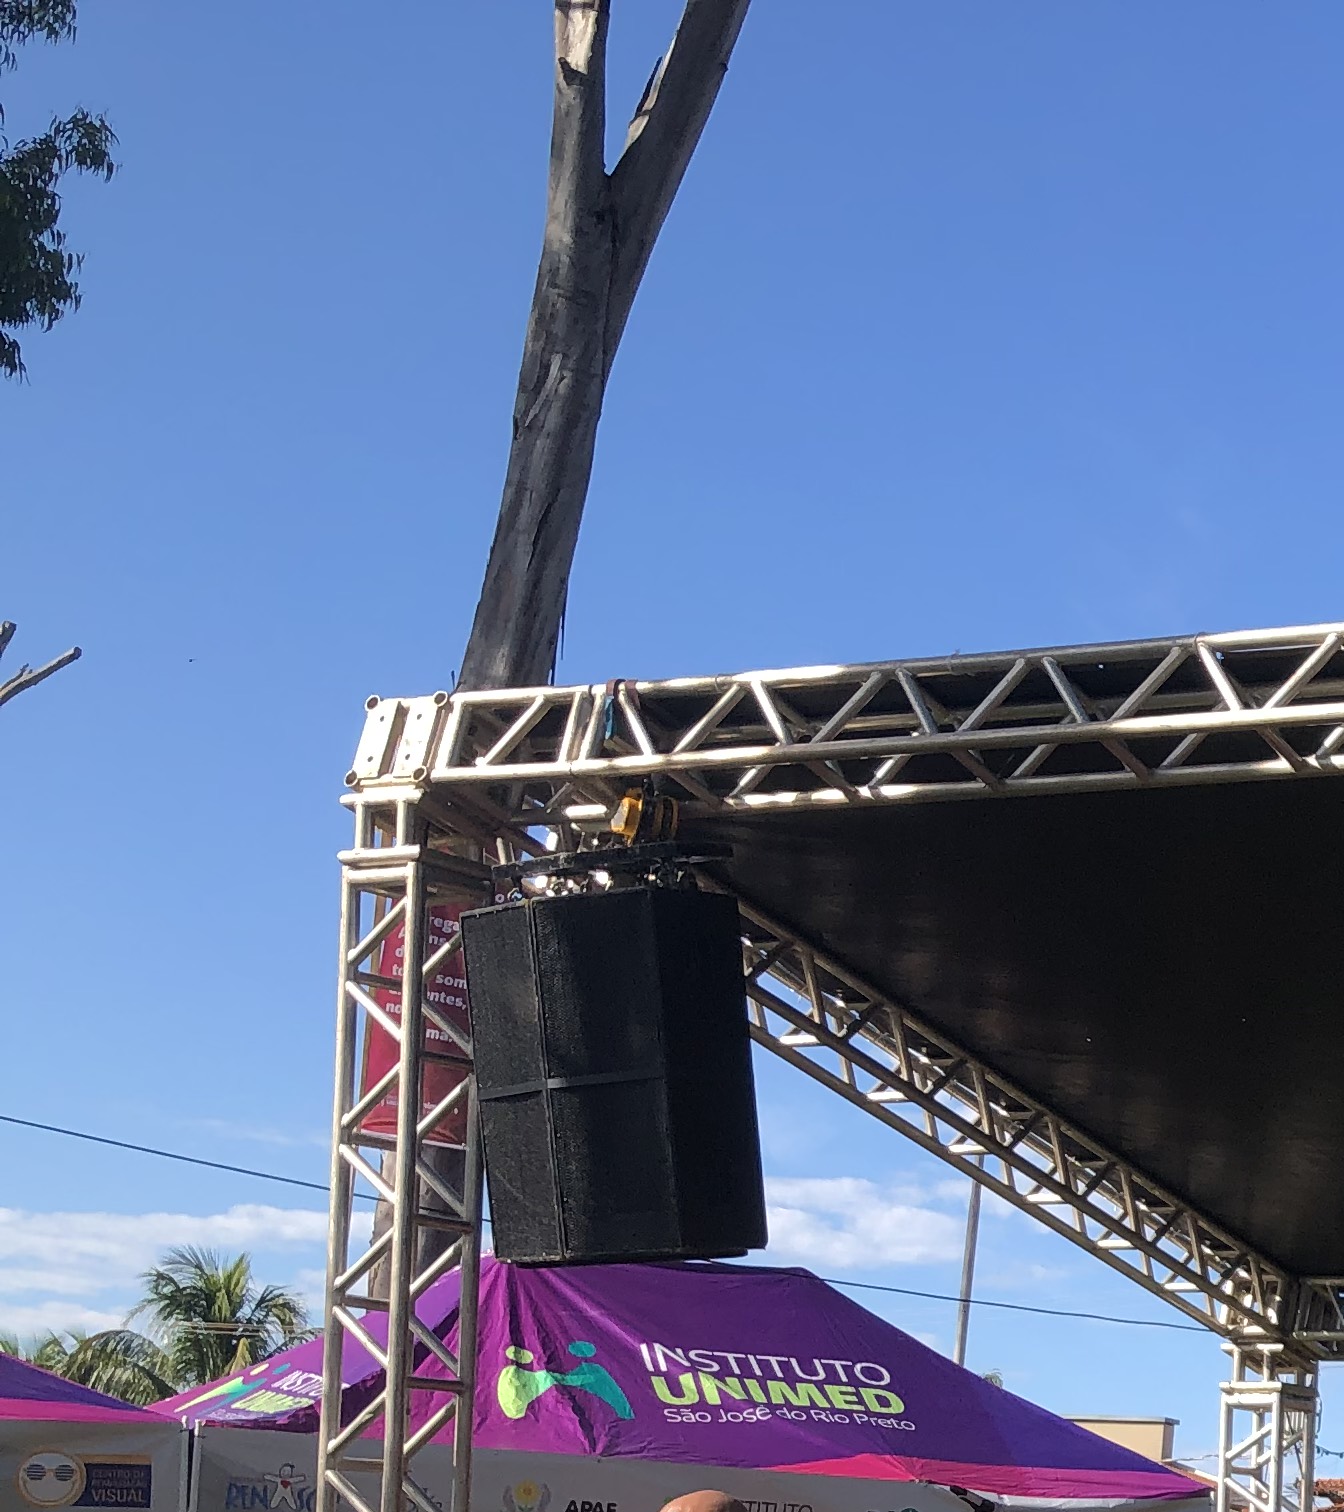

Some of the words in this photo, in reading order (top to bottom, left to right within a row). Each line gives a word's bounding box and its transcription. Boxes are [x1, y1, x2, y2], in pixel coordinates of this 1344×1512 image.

[640, 1343, 891, 1386] INSTITUTO
[651, 1371, 905, 1415] UNIMED
[663, 1408, 711, 1423] São
[717, 1405, 772, 1424] José
[776, 1409, 807, 1421] do
[810, 1409, 850, 1424] Rio
[854, 1412, 916, 1431] Preto
[91, 1488, 145, 1503] VISUAL
